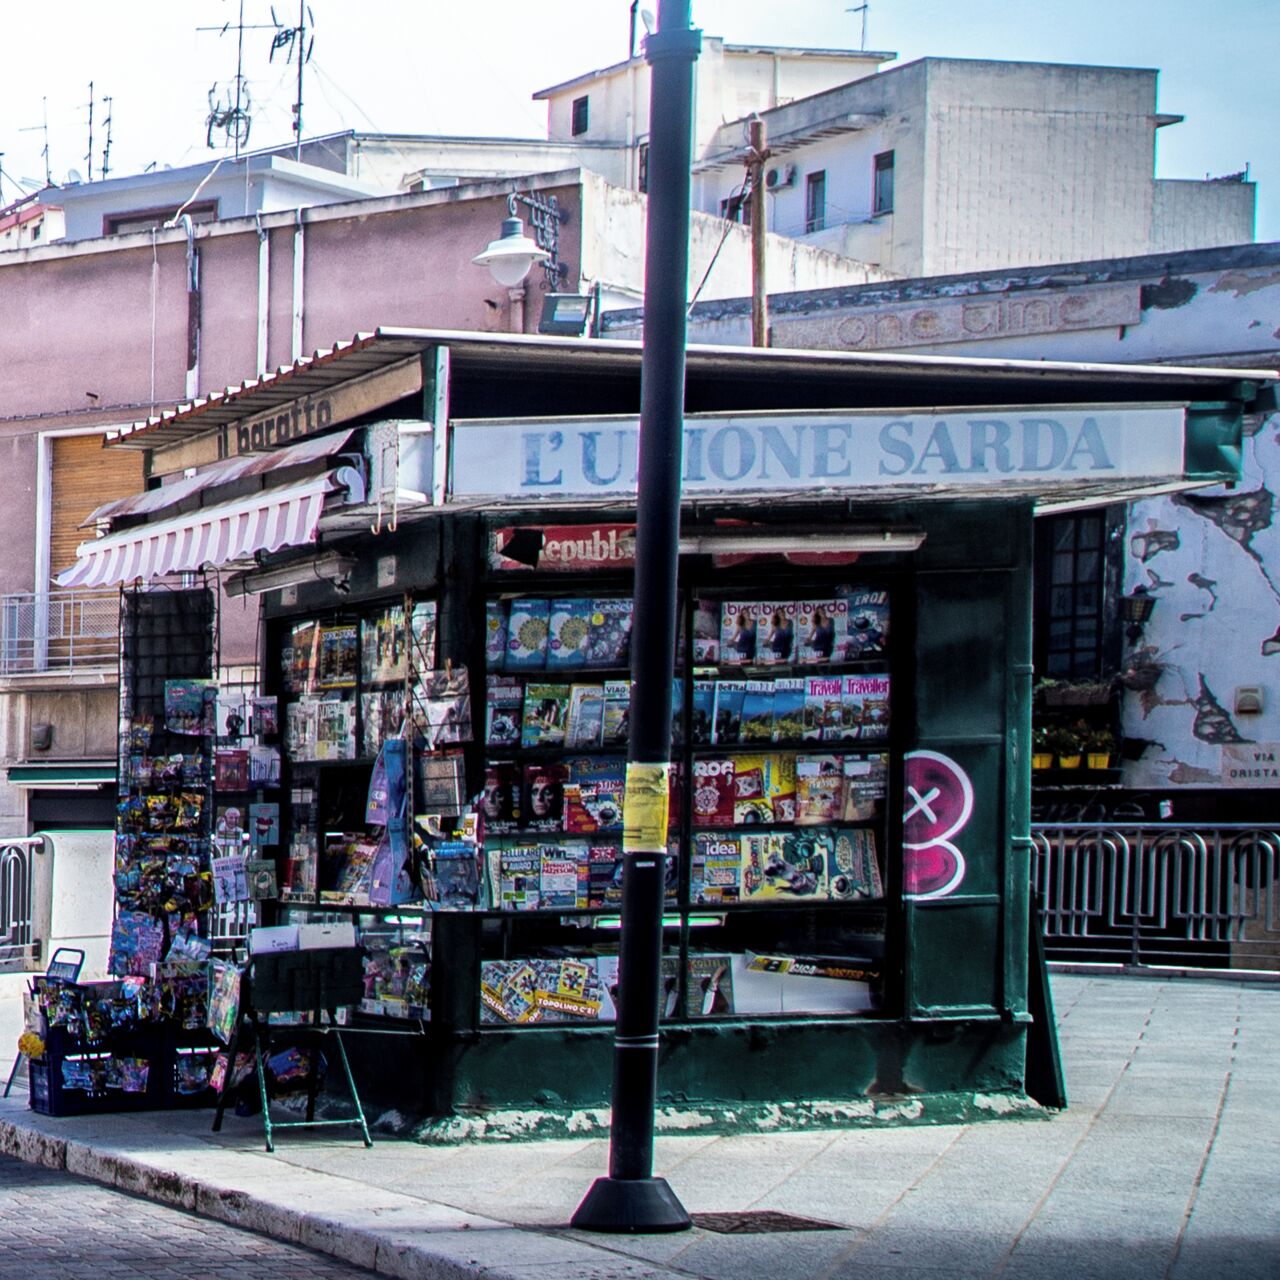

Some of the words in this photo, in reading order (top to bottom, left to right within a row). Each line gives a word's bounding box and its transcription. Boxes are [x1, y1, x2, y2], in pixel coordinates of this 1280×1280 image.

[217, 423, 229, 461] il
[236, 399, 332, 454] baratto
[518, 421, 852, 490] L'UIONE
[877, 416, 1116, 476] SARDA
[1253, 752, 1275, 762] VIA
[1229, 768, 1279, 778] ORISTA
[538, 998, 579, 1012] TOPOLINO
